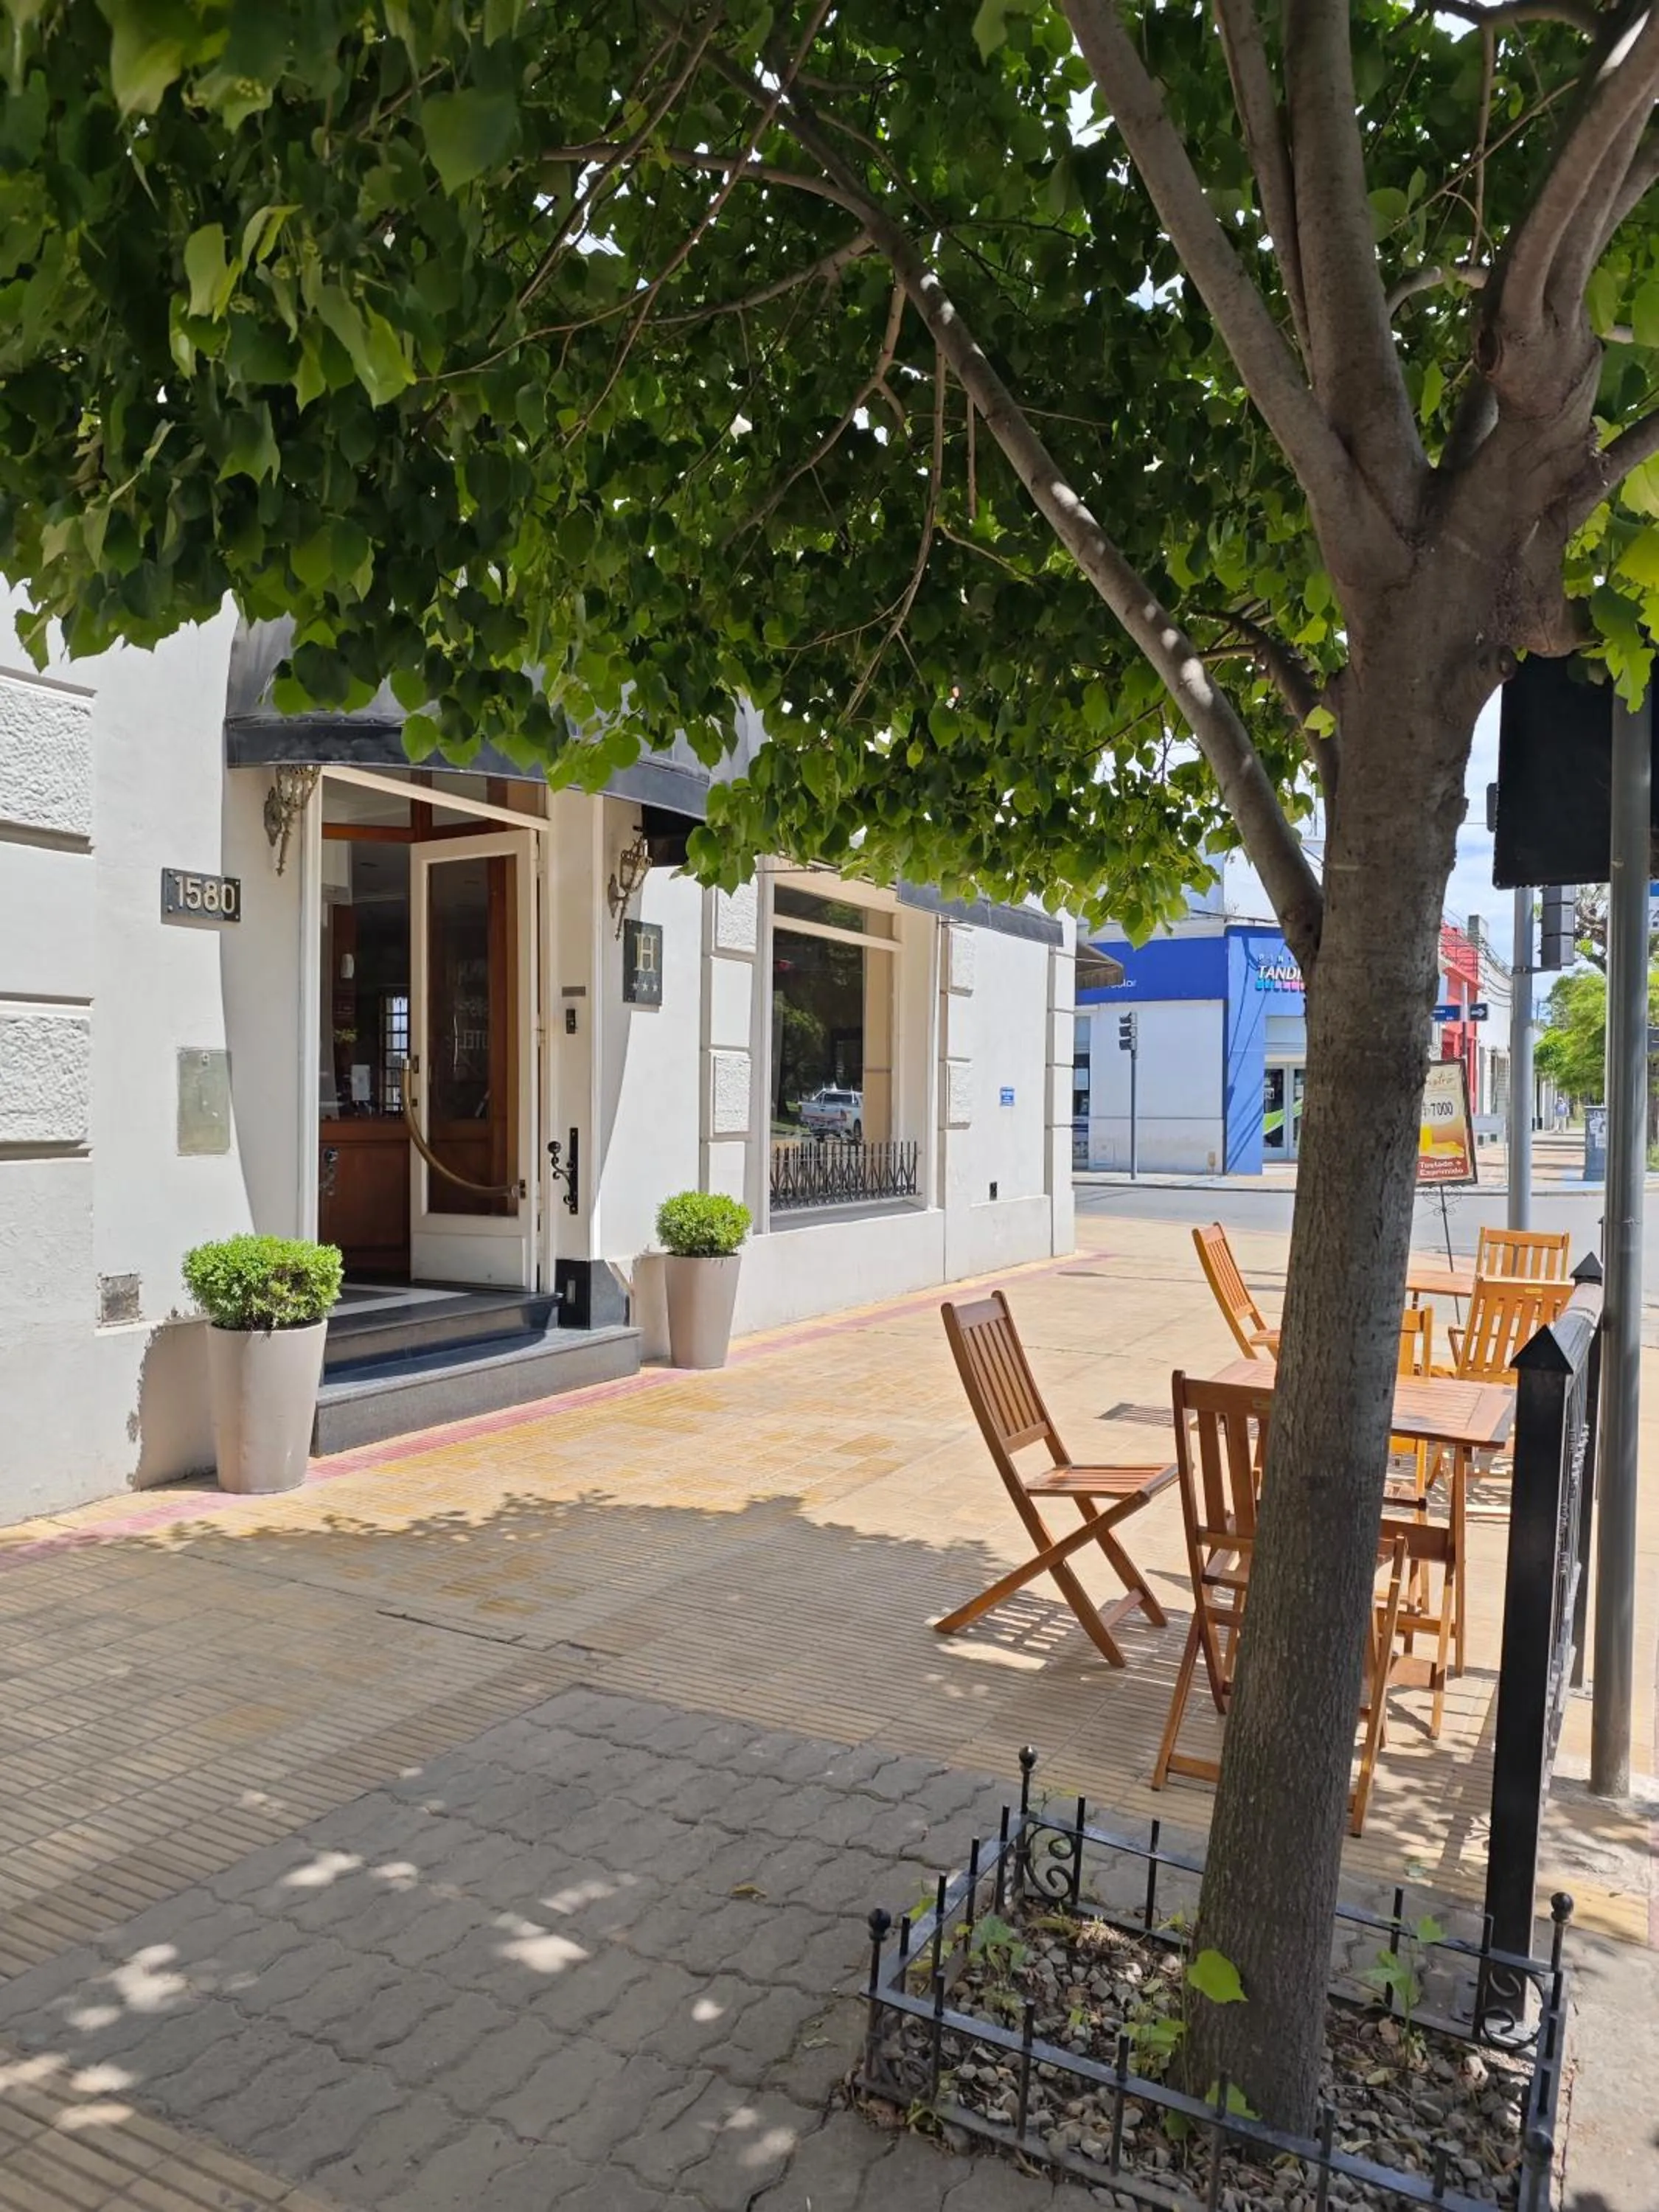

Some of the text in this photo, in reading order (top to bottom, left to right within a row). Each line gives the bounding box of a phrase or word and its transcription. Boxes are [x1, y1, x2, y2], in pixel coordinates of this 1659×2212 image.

[175, 875, 235, 914] 1580
[634, 933, 657, 973] H
[1258, 965, 1303, 980] TANDI
